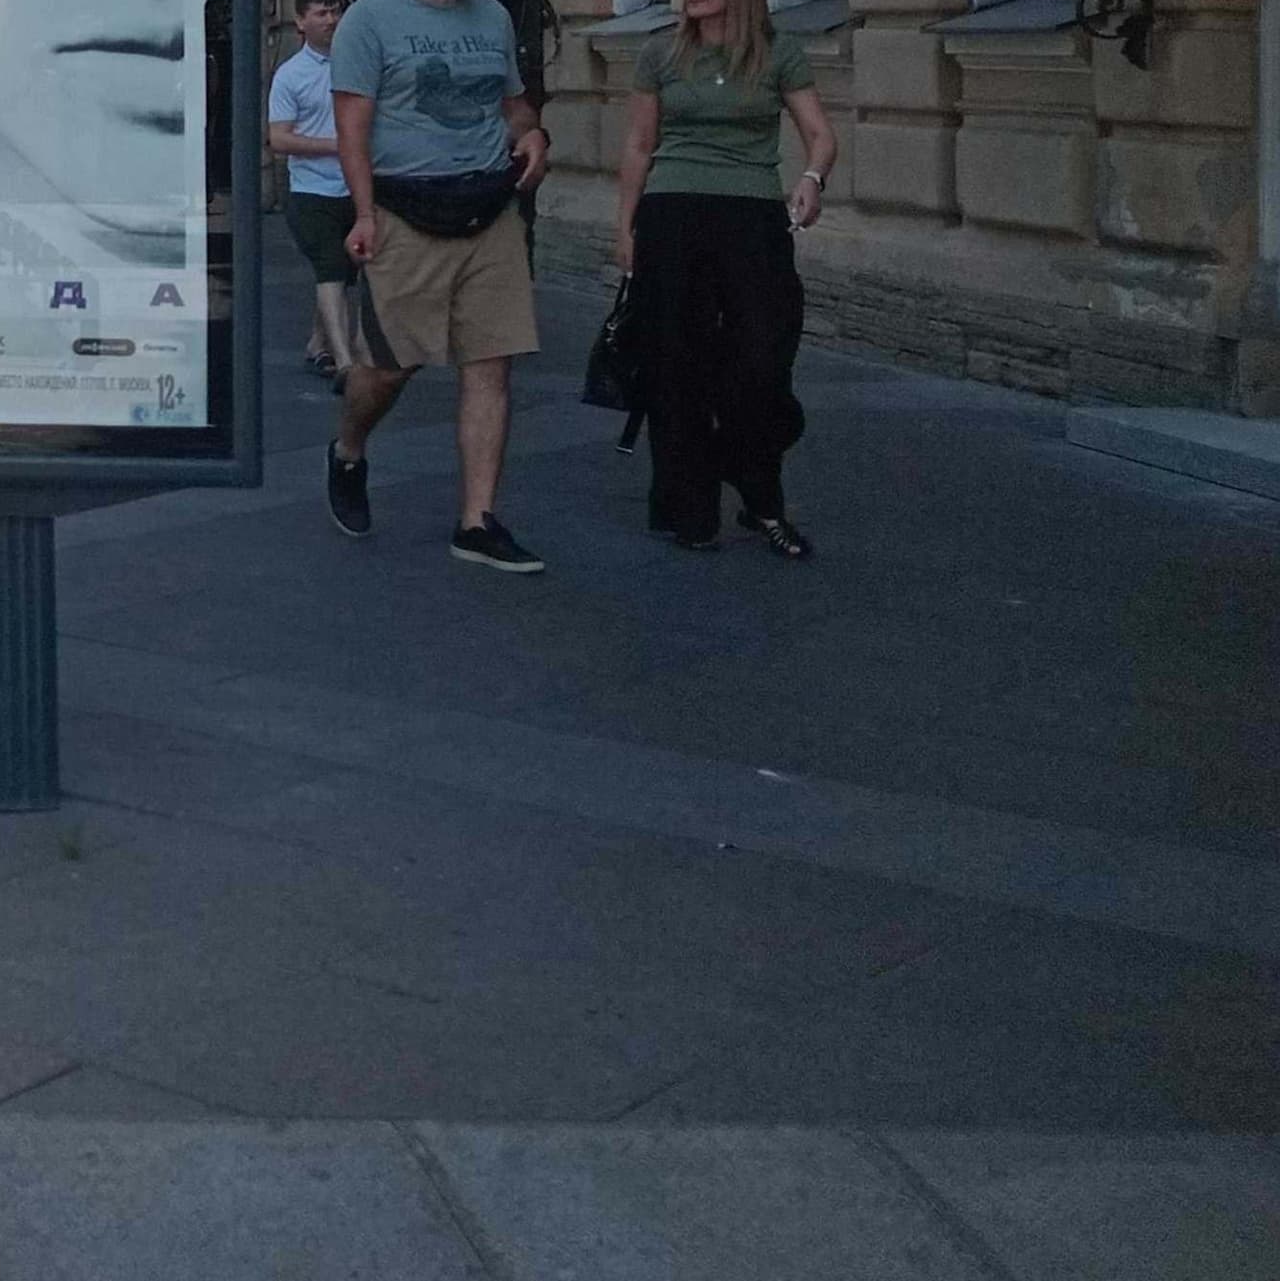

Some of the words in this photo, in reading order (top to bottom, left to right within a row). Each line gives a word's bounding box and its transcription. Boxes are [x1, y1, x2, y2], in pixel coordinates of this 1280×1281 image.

[403, 33, 448, 54] Take
[451, 39, 462, 55] a
[157, 373, 186, 411] 12+
